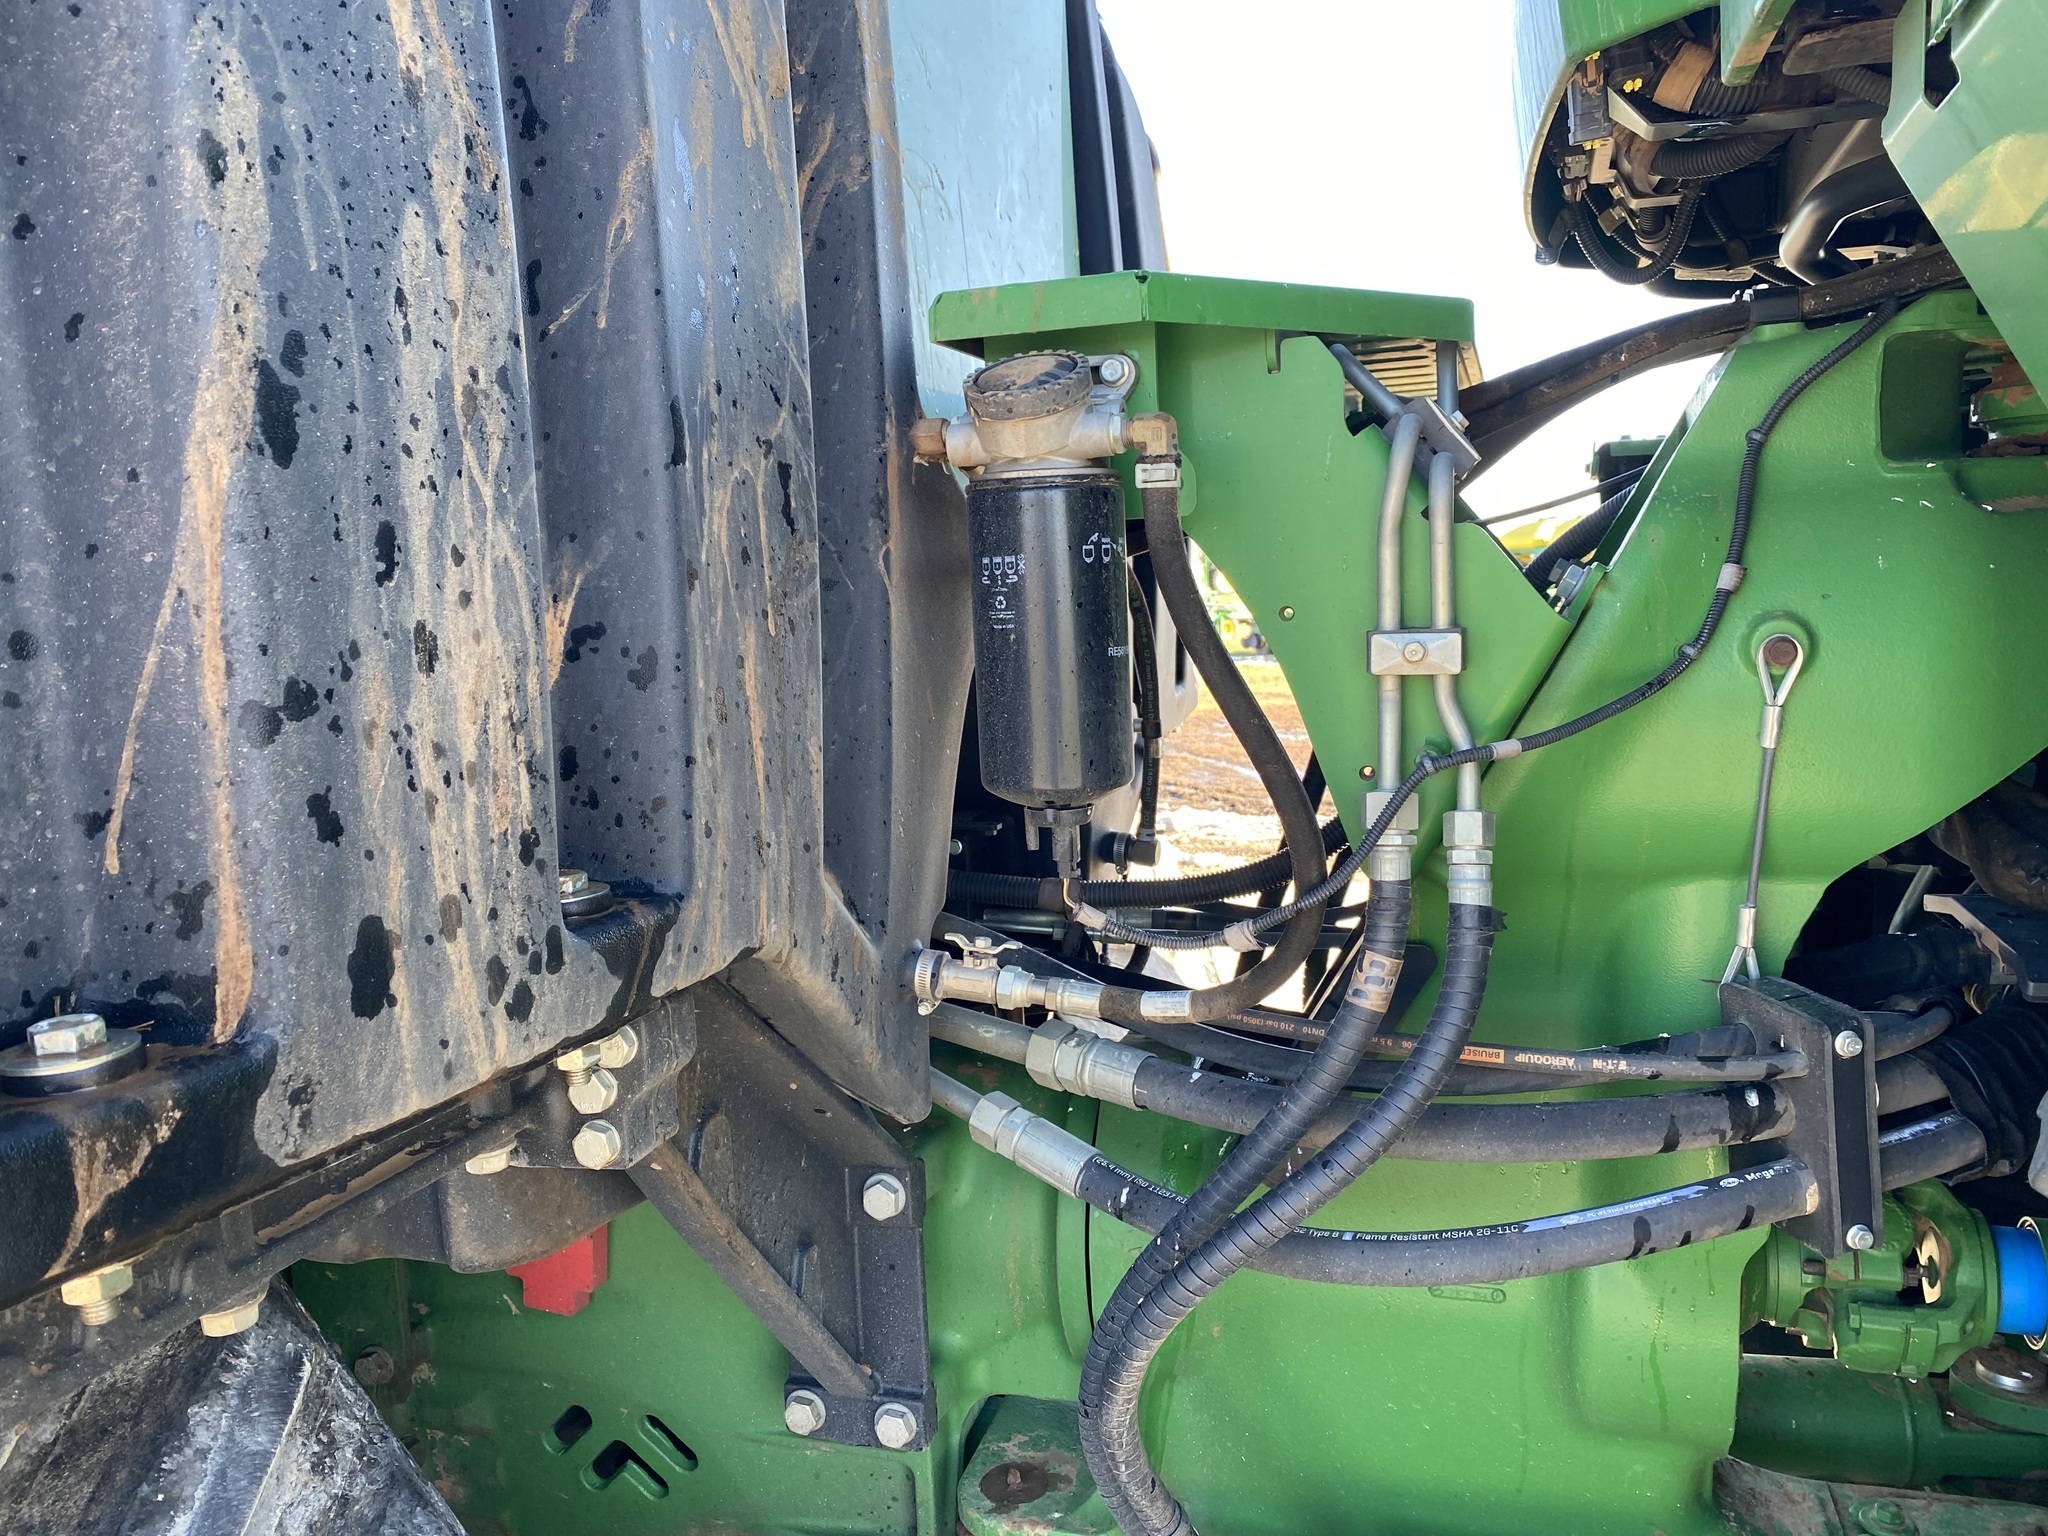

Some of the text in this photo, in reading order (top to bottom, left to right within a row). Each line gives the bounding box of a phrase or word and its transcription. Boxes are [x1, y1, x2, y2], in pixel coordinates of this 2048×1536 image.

[1243, 1016, 1264, 1026] (3050
[1265, 1019, 1278, 1028] bar
[1280, 1022, 1295, 1031] 210
[1302, 1026, 1325, 1036] DN10
[1515, 1053, 1576, 1067] AEROQUIP
[1133, 1177, 1149, 1188] ISO
[1308, 1228, 1330, 1238] Type
[1356, 1232, 1388, 1241] Flame
[1389, 1232, 1440, 1241] Resistant
[1442, 1230, 1474, 1239] MSHA
